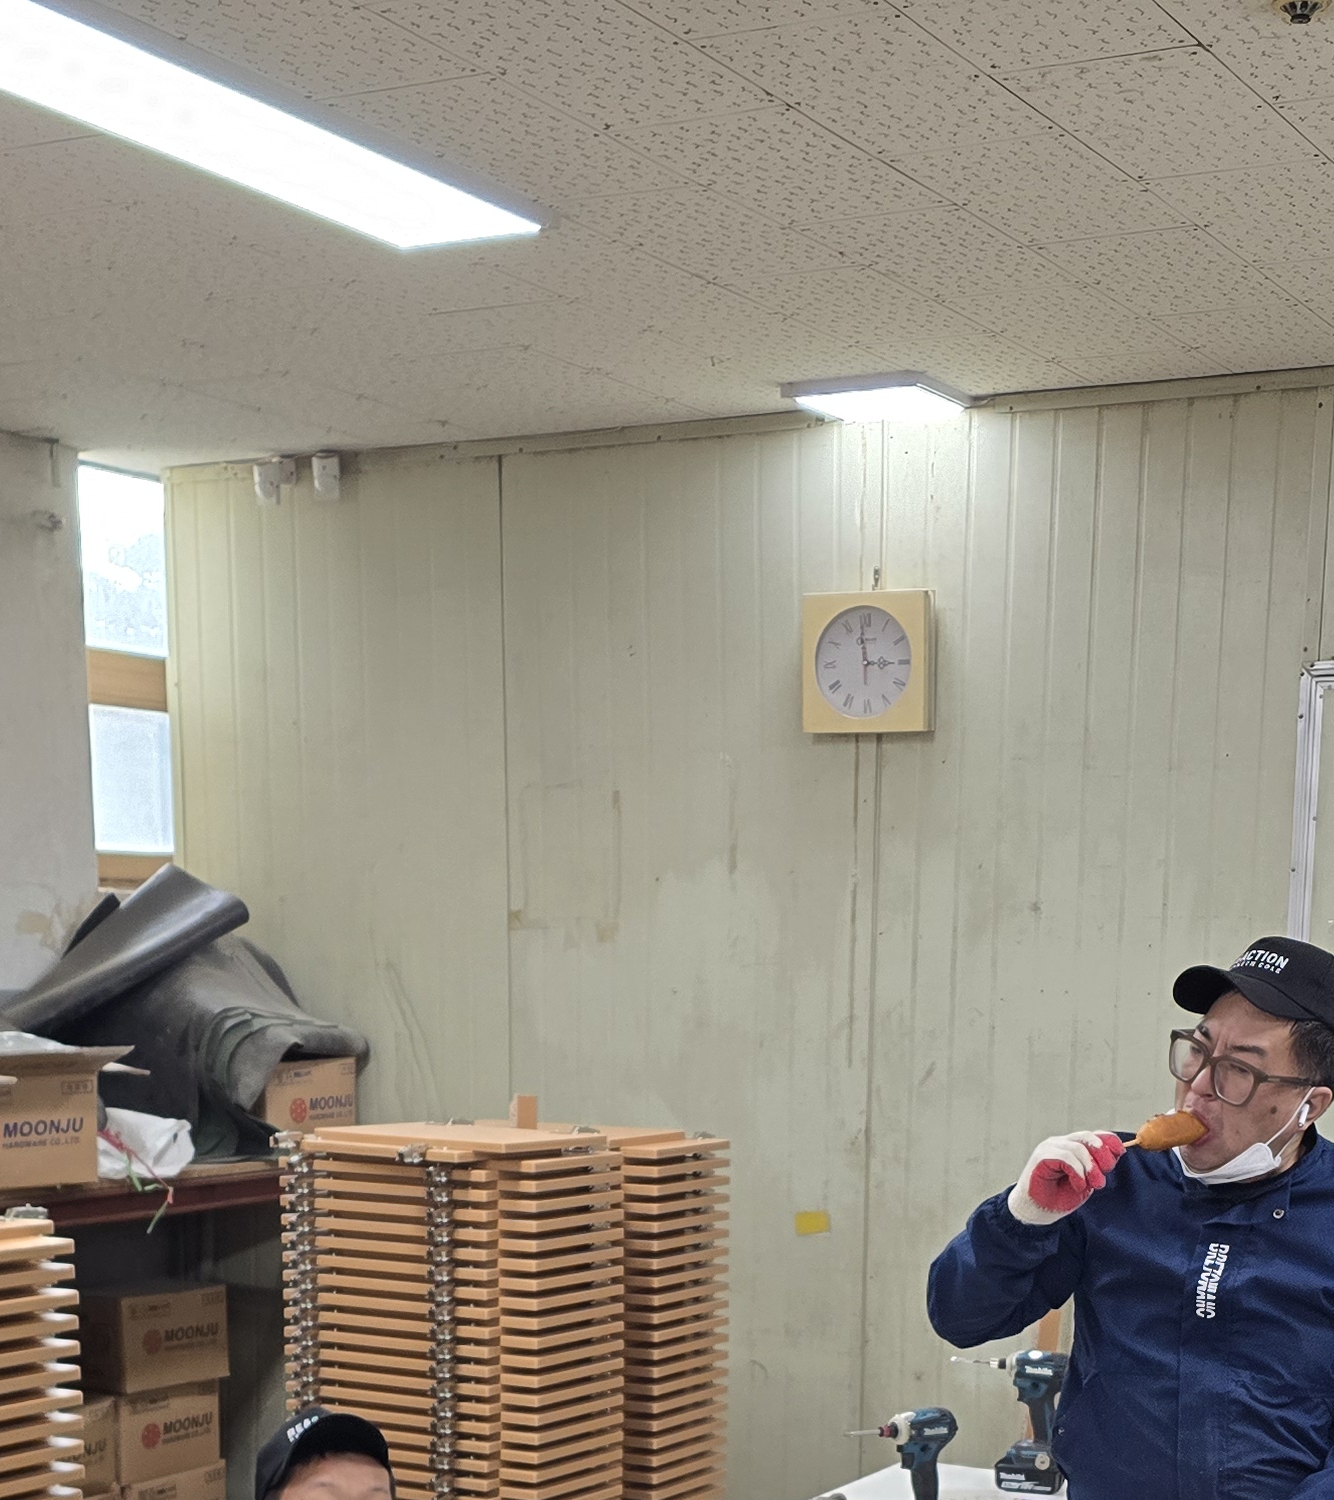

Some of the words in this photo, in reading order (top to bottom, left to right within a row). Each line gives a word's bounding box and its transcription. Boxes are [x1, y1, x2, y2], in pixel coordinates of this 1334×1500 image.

[308, 1094, 354, 1111] MOONJU
[3, 1116, 84, 1138] MOONJU
[163, 1322, 220, 1342] MOONJU
[163, 1411, 214, 1435] MOONJU
